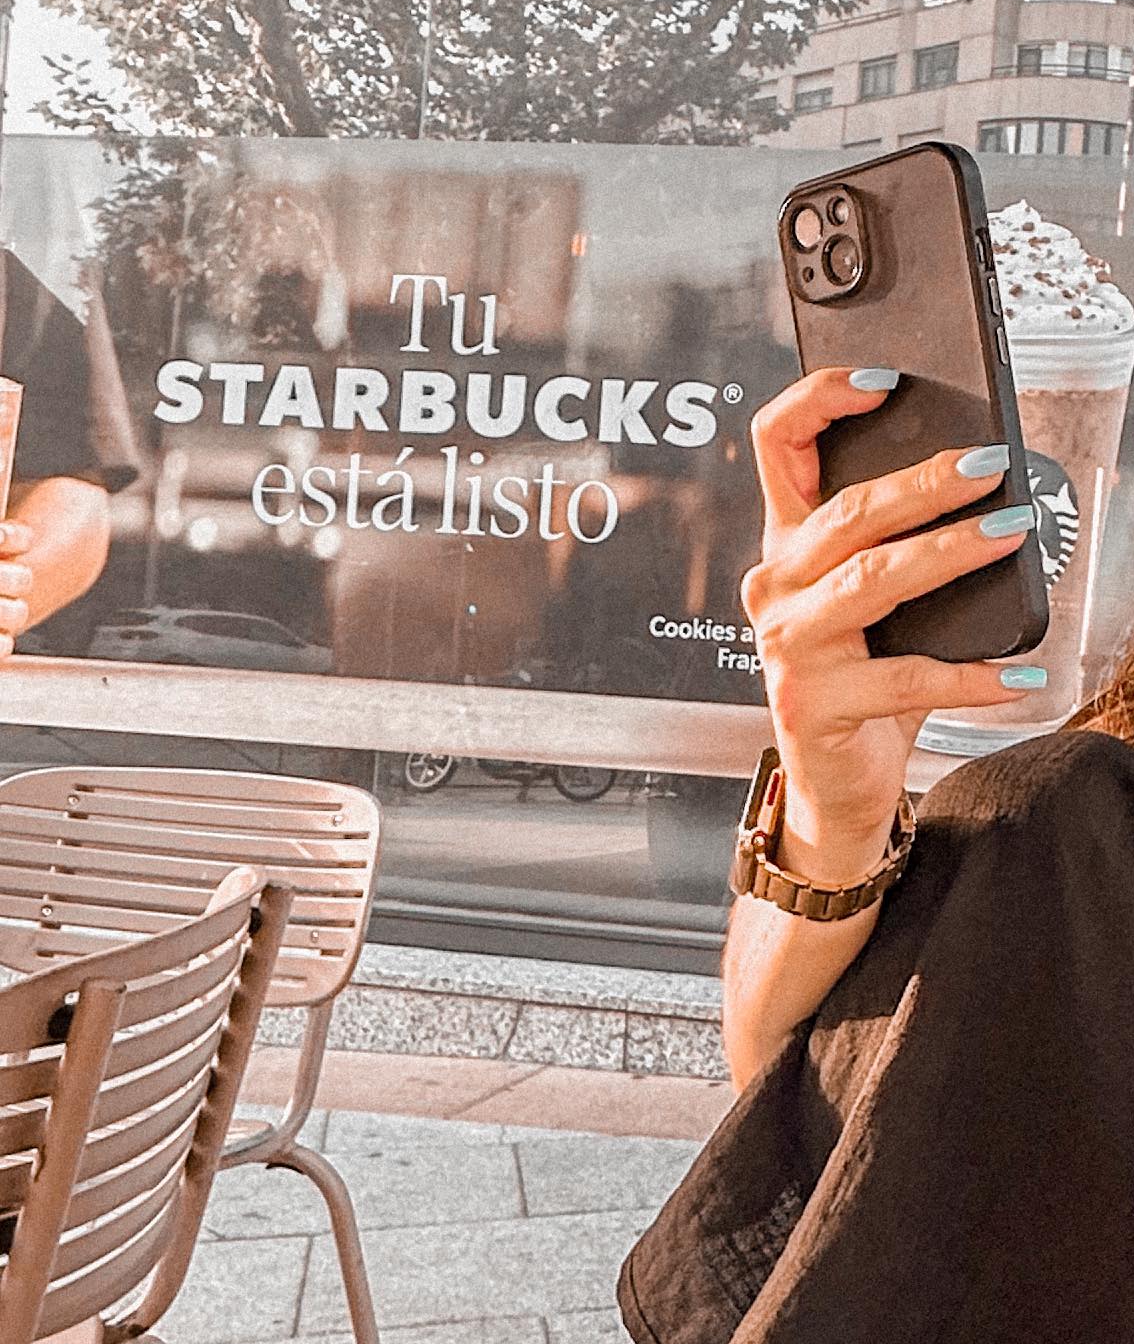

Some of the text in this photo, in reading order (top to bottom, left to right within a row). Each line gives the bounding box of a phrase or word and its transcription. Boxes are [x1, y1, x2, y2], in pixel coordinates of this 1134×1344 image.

[389, 272, 501, 356] Tu
[250, 445, 619, 545] está listo
[648, 614, 737, 643] Cookies
